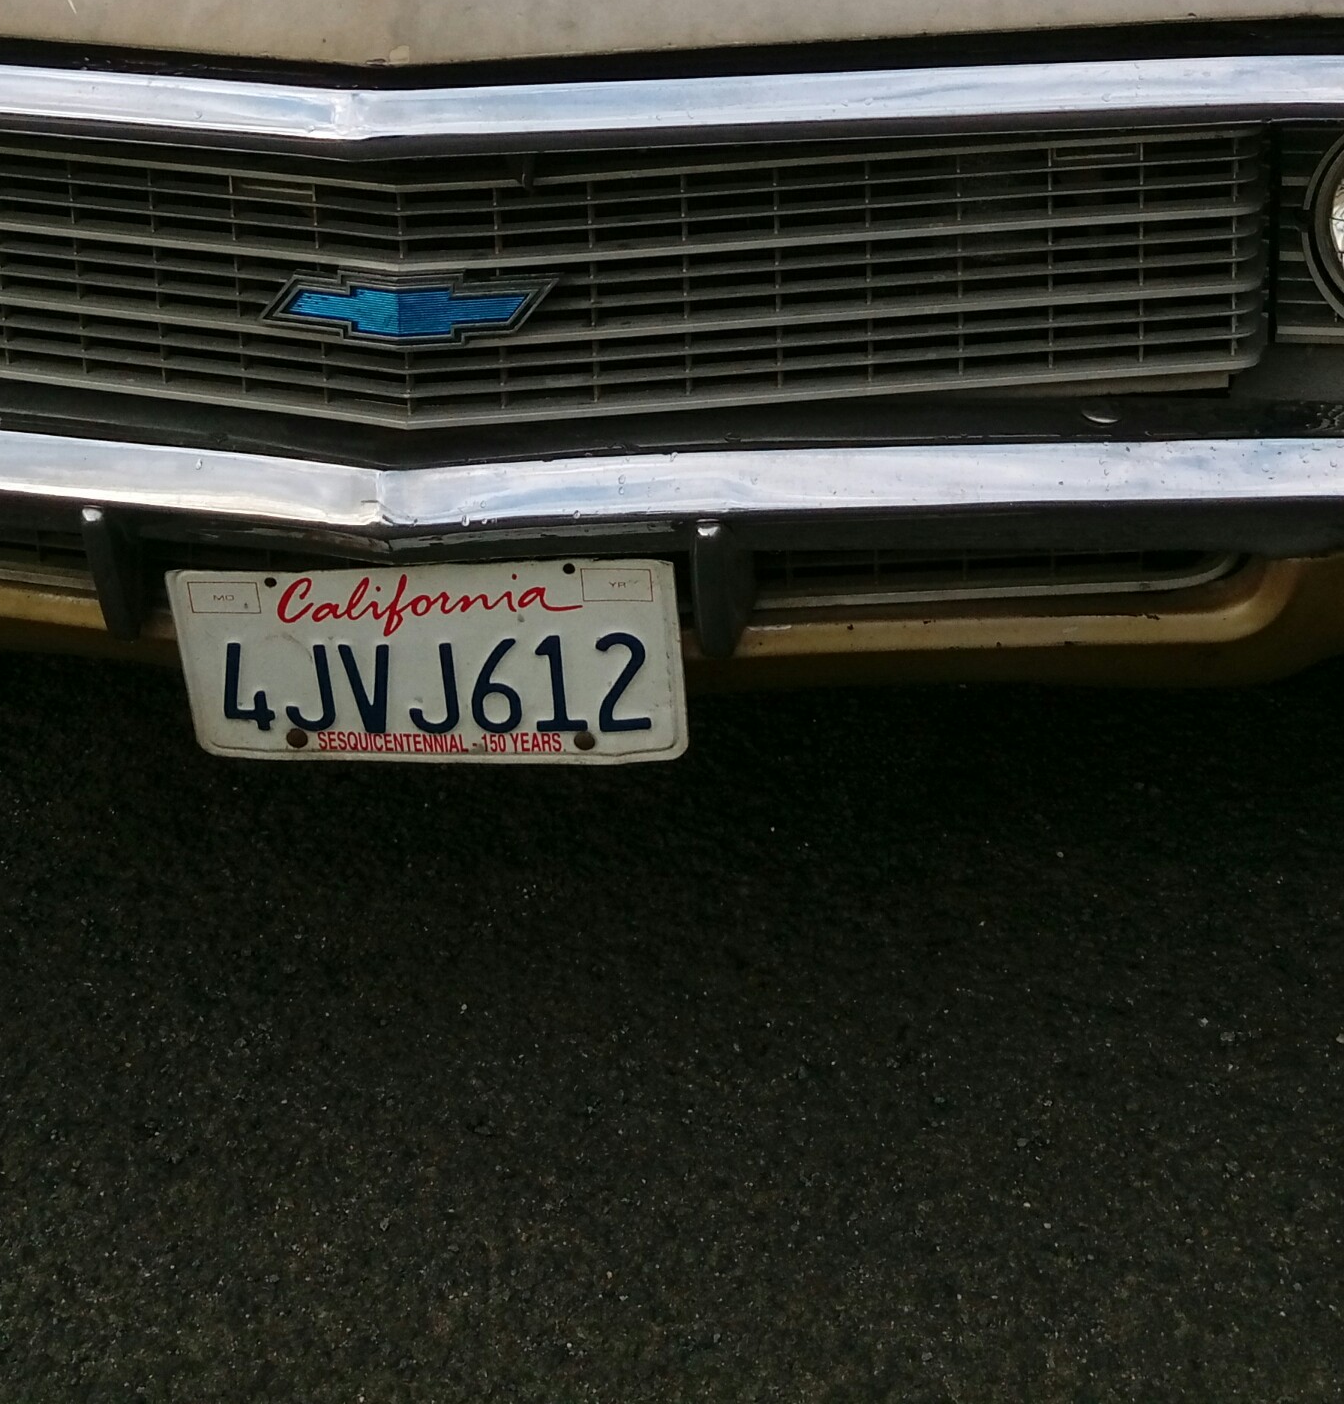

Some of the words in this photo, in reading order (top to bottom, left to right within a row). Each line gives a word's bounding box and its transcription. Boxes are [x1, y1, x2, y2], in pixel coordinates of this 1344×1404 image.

[608, 581, 627, 589] YR
[213, 594, 235, 602] MO
[277, 574, 584, 637] California
[223, 632, 652, 734] 4JVJ612
[317, 731, 469, 753] SESQUICENTENNIAL
[481, 733, 506, 753] 150
[511, 732, 563, 753] YEARS
